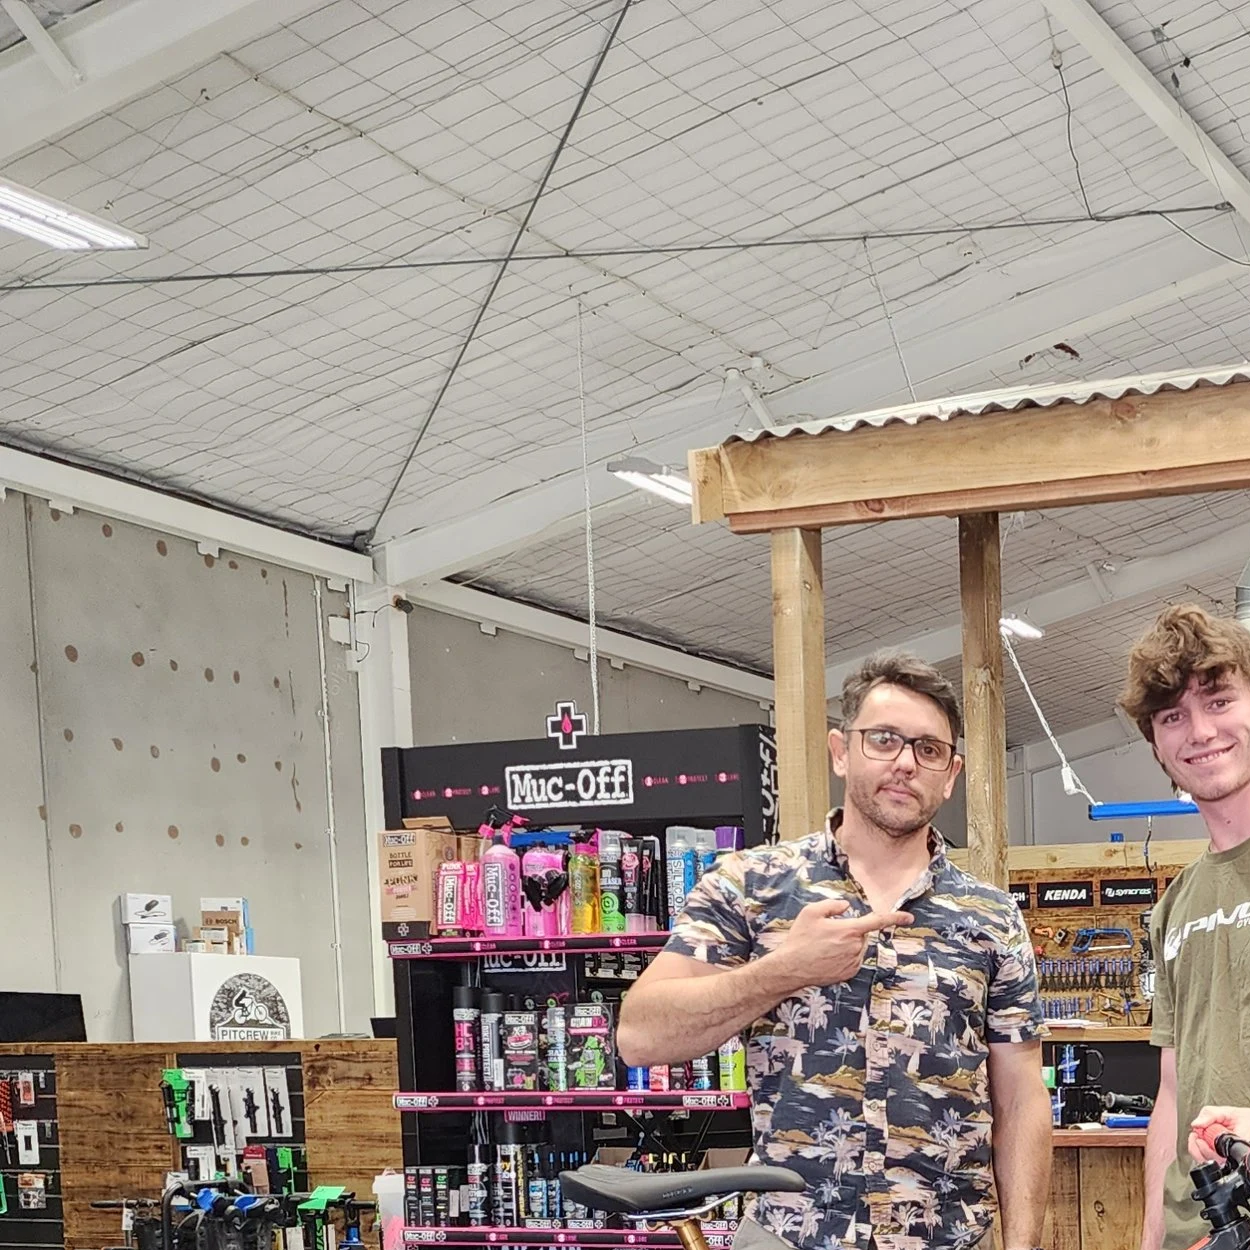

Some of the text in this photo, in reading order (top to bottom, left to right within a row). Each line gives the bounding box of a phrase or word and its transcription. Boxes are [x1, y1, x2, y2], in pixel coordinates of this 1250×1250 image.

[512, 765, 628, 803] Muc-Off
[385, 832, 415, 845] Muc-Off
[444, 877, 456, 923] Muc-Off
[486, 864, 502, 925] Muc-Off
[1044, 889, 1087, 901] KENDA
[221, 1029, 269, 1040] PITCREW
[684, 1096, 717, 1106] Muc-Off
